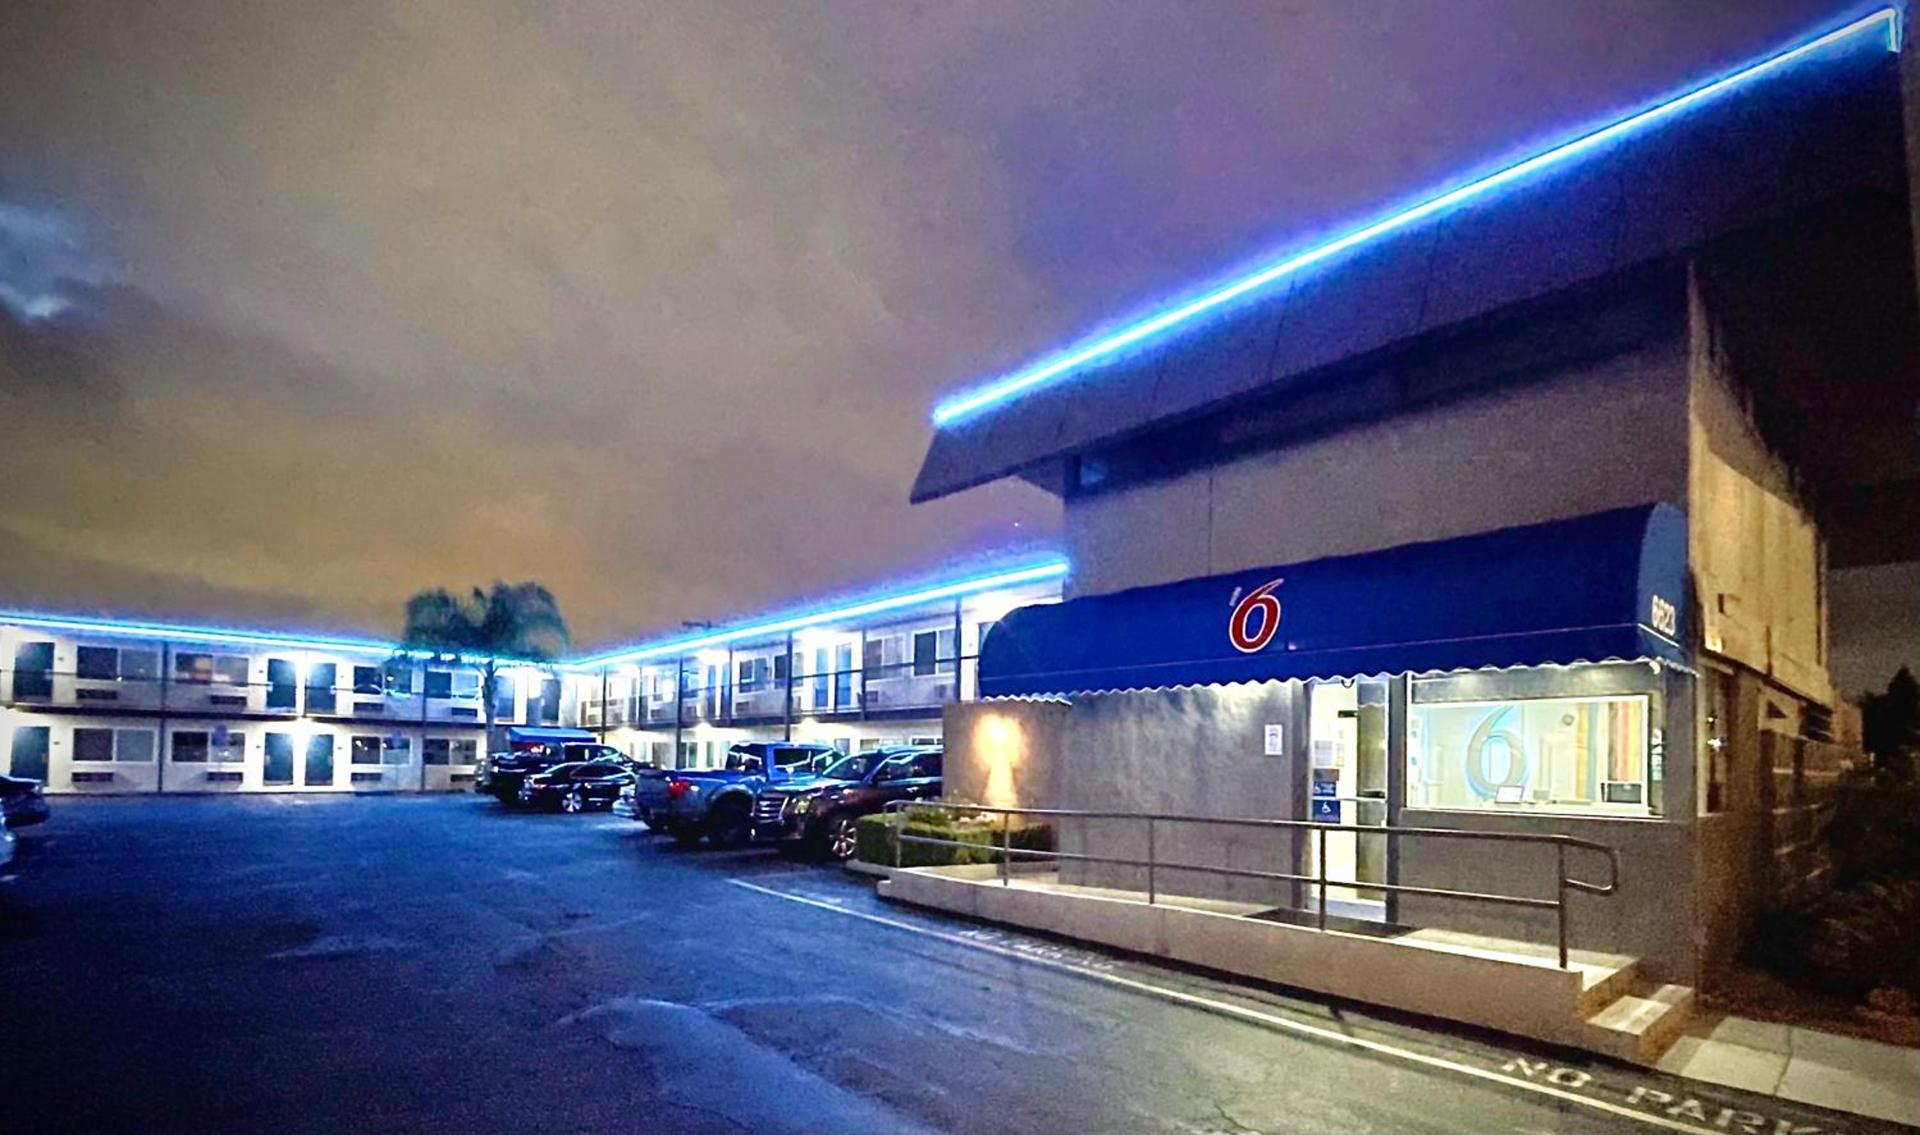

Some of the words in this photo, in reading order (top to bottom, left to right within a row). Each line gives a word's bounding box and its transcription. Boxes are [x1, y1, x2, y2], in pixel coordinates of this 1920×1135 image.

[1229, 578, 1284, 653] 6
[1465, 704, 1527, 799] 6
[1502, 1058, 1592, 1088] NO
